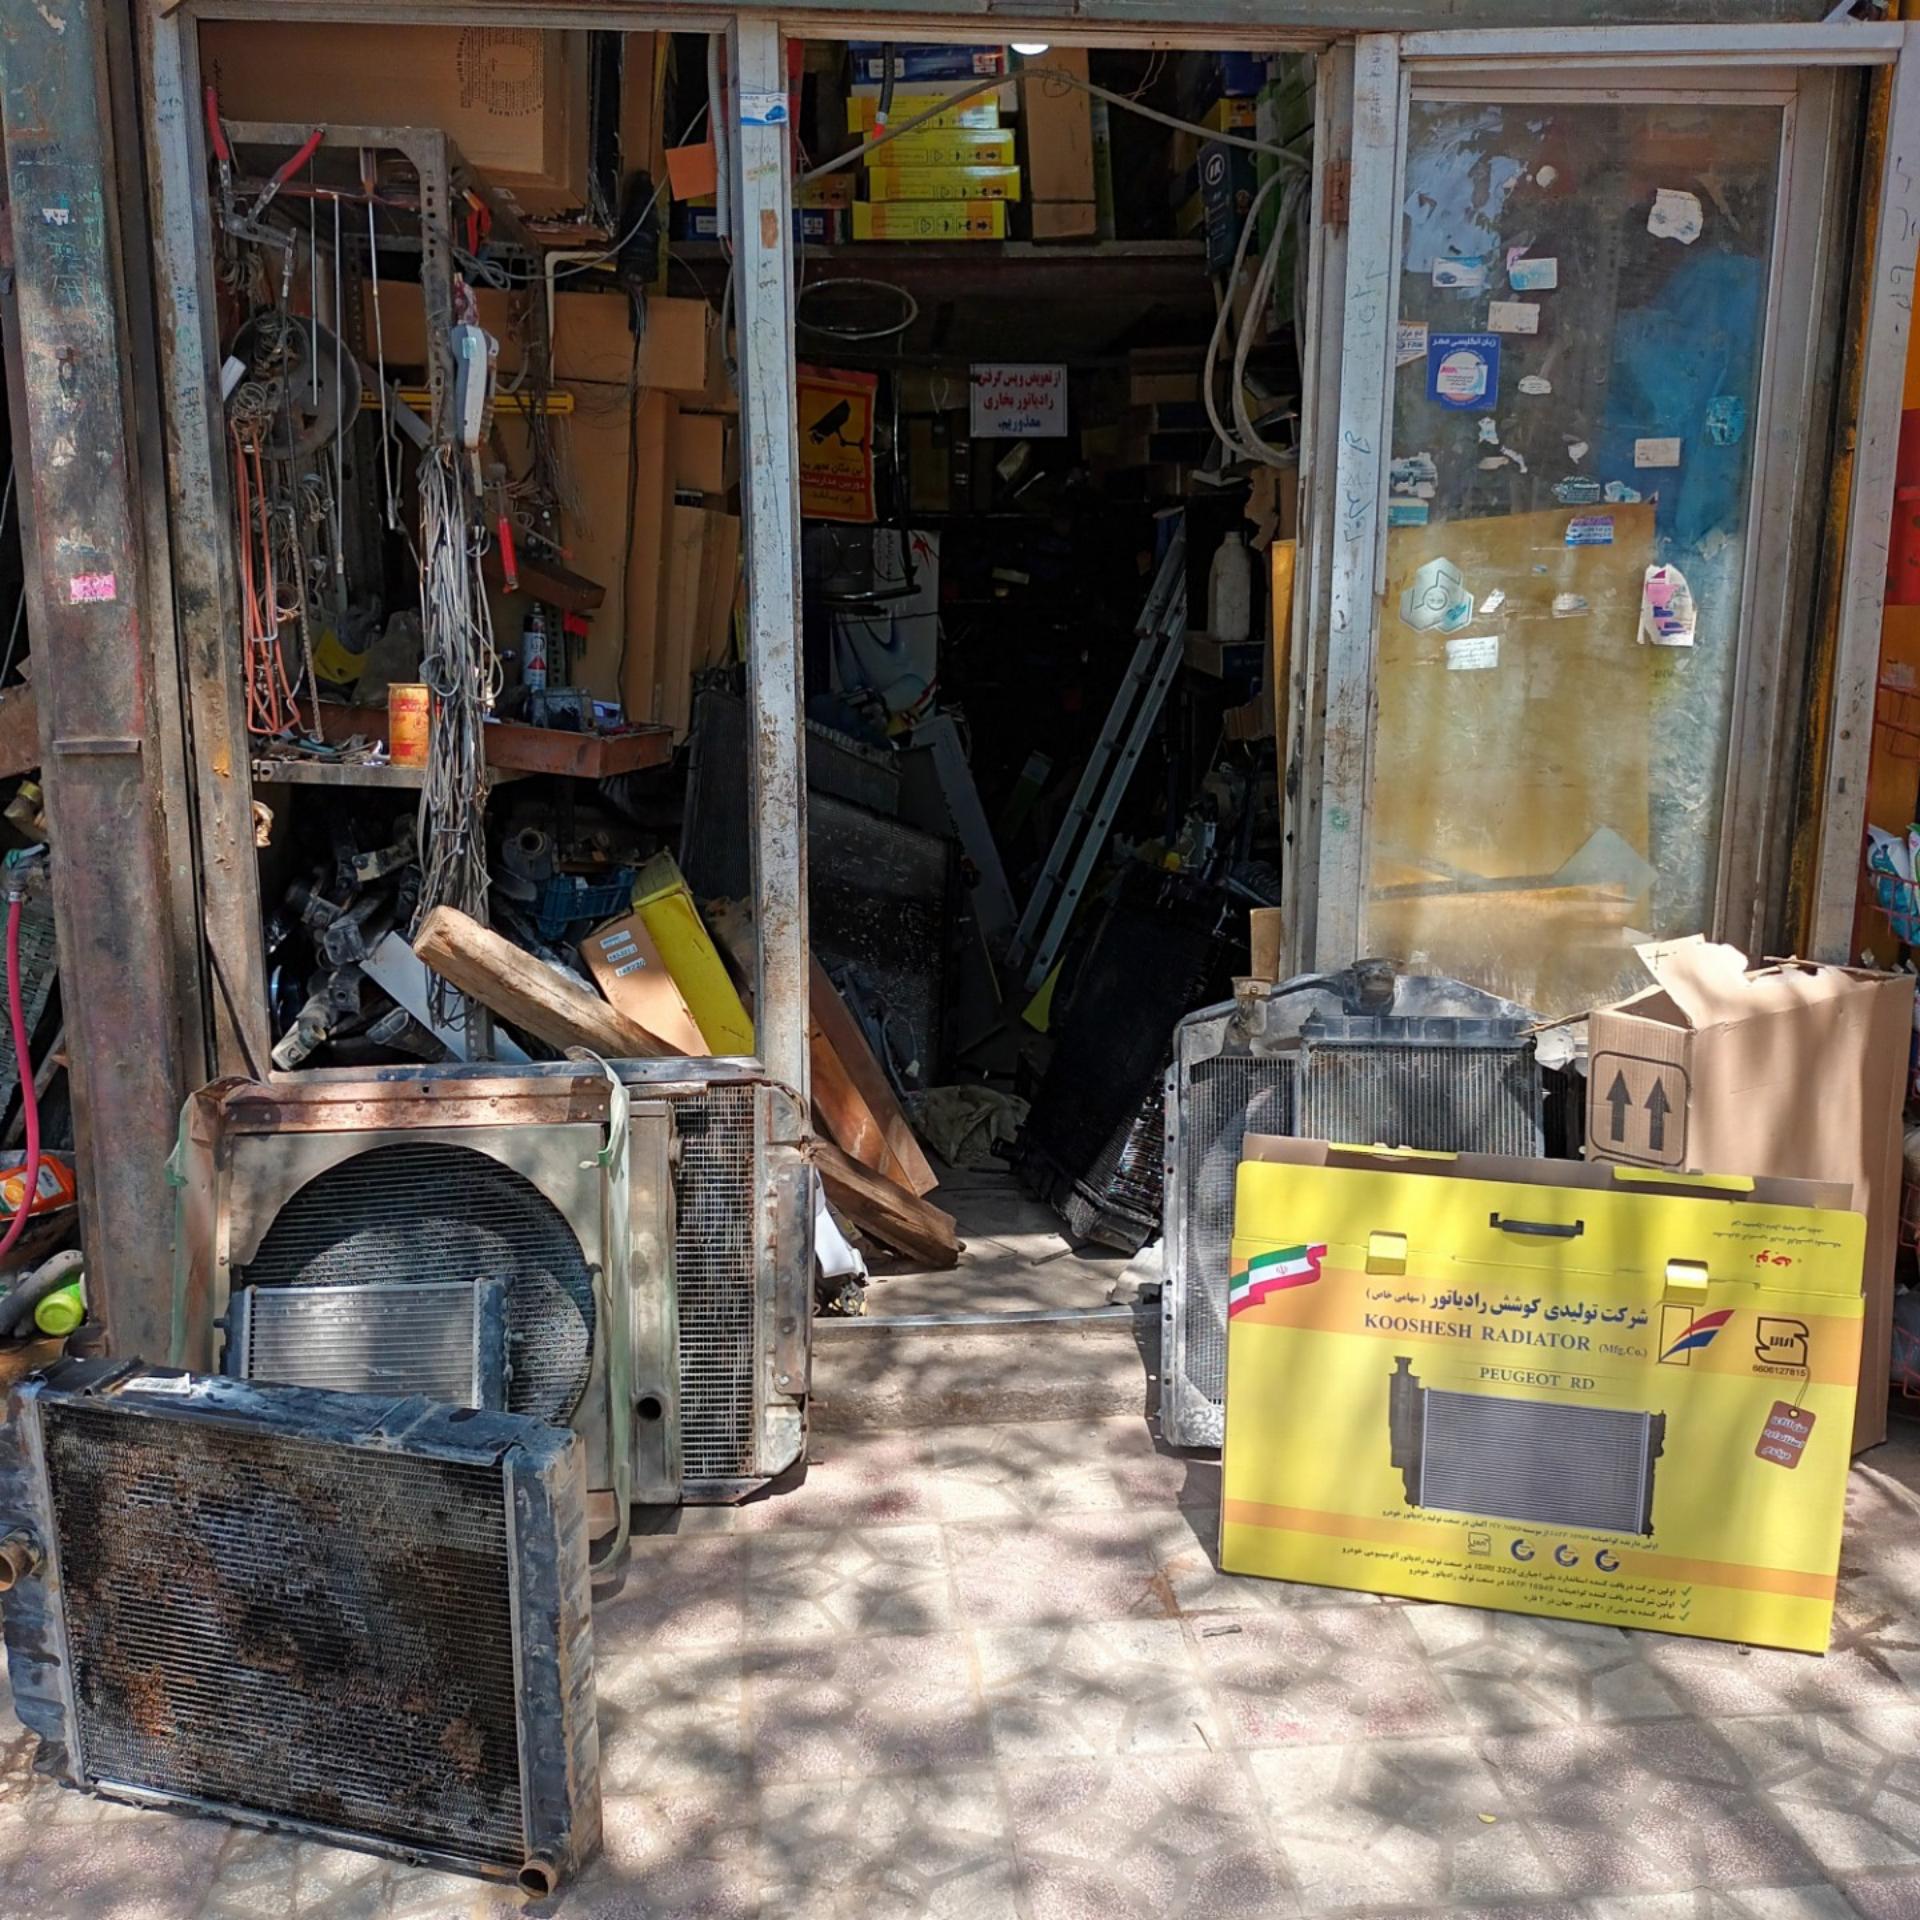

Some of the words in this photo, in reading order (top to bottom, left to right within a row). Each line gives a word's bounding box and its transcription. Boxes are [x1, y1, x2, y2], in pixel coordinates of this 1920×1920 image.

[976, 366, 1002, 387] گرفتن
[1024, 369, 1053, 387] تعویض
[1053, 368, 1061, 387] از
[983, 392, 1015, 411] بخاری
[1017, 392, 1054, 411] رادیاتور
[838, 479, 865, 490] دوربین
[1429, 1290, 1488, 1314] رادیاتور
[1490, 1294, 1541, 1318] کوشش
[1543, 1301, 1598, 1324] تولیدی
[1600, 1307, 1648, 1329] شرکت
[1364, 1312, 1472, 1339] KOOSHESH
[1481, 1325, 1591, 1351] RADIATOR
[1480, 1366, 1560, 1387] PEUGEOT
[1570, 1377, 1595, 1390] RD
